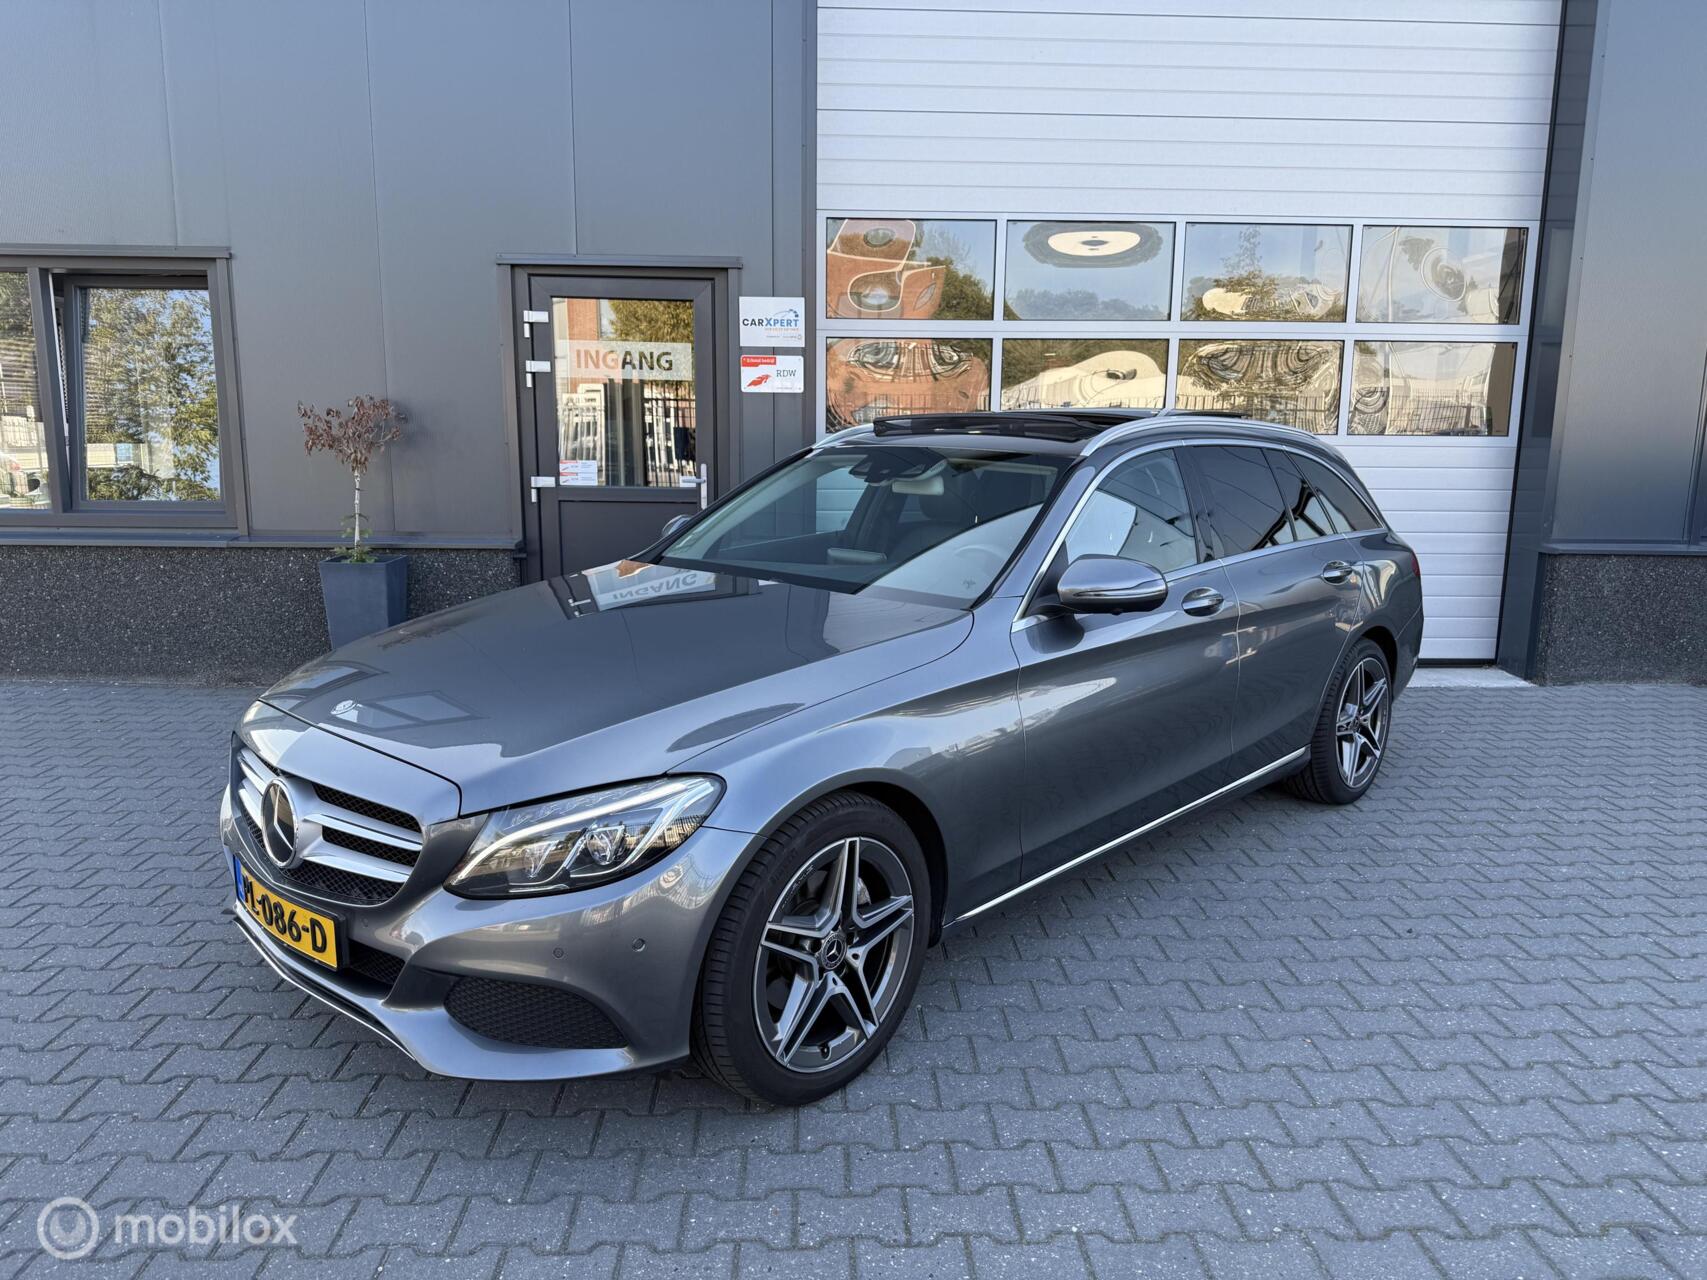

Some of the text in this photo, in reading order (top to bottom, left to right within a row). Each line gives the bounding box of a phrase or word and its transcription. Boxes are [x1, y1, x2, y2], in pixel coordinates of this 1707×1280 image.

[742, 317, 799, 327] CARXPERT
[576, 349, 673, 371] INGANG
[776, 369, 797, 377] RDW
